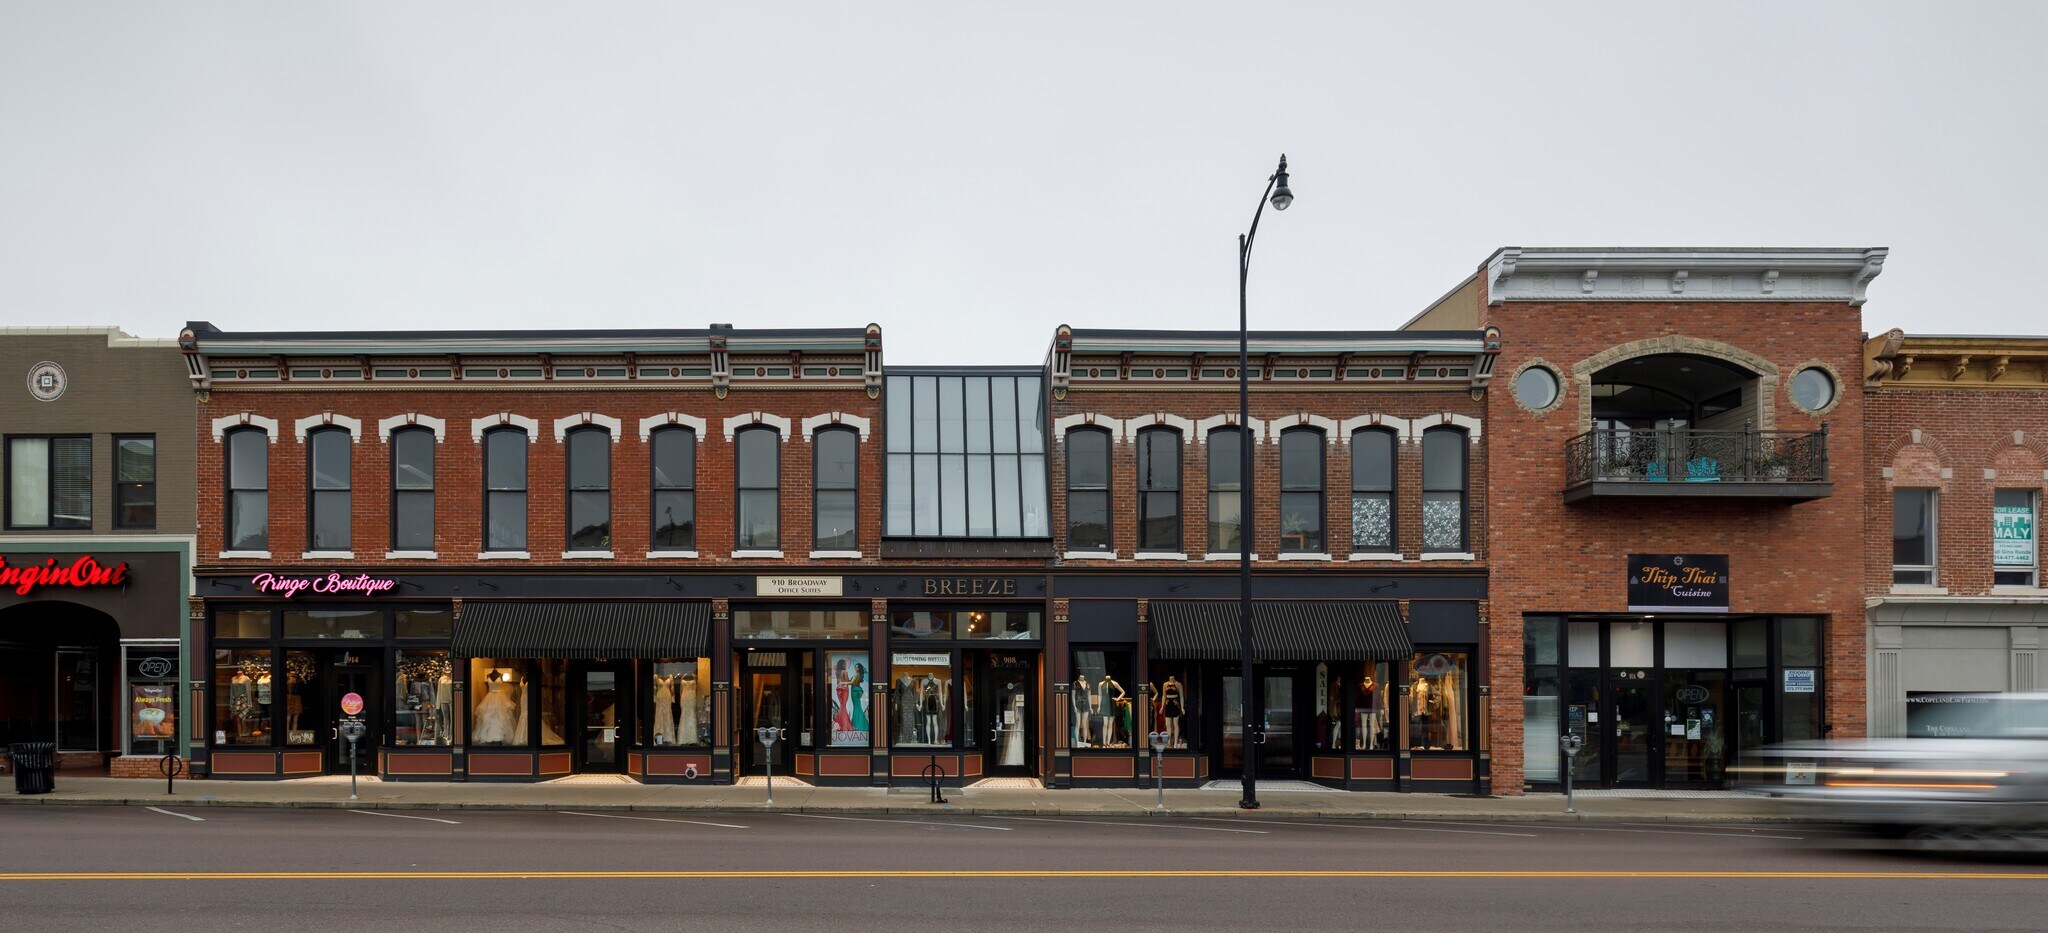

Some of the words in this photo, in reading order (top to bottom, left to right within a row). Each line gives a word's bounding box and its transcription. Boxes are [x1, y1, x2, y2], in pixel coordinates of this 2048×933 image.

[1994, 527, 2030, 538] MALY
[1641, 566, 1678, 589] Thip
[1681, 566, 1717, 584] Thai
[252, 573, 310, 598] Fringe
[313, 573, 395, 596] Boutique
[924, 579, 1015, 595] BREEZE
[1671, 585, 1711, 597] Cuisine
[141, 662, 169, 673] OPEN
[1677, 689, 1704, 700] OPEN
